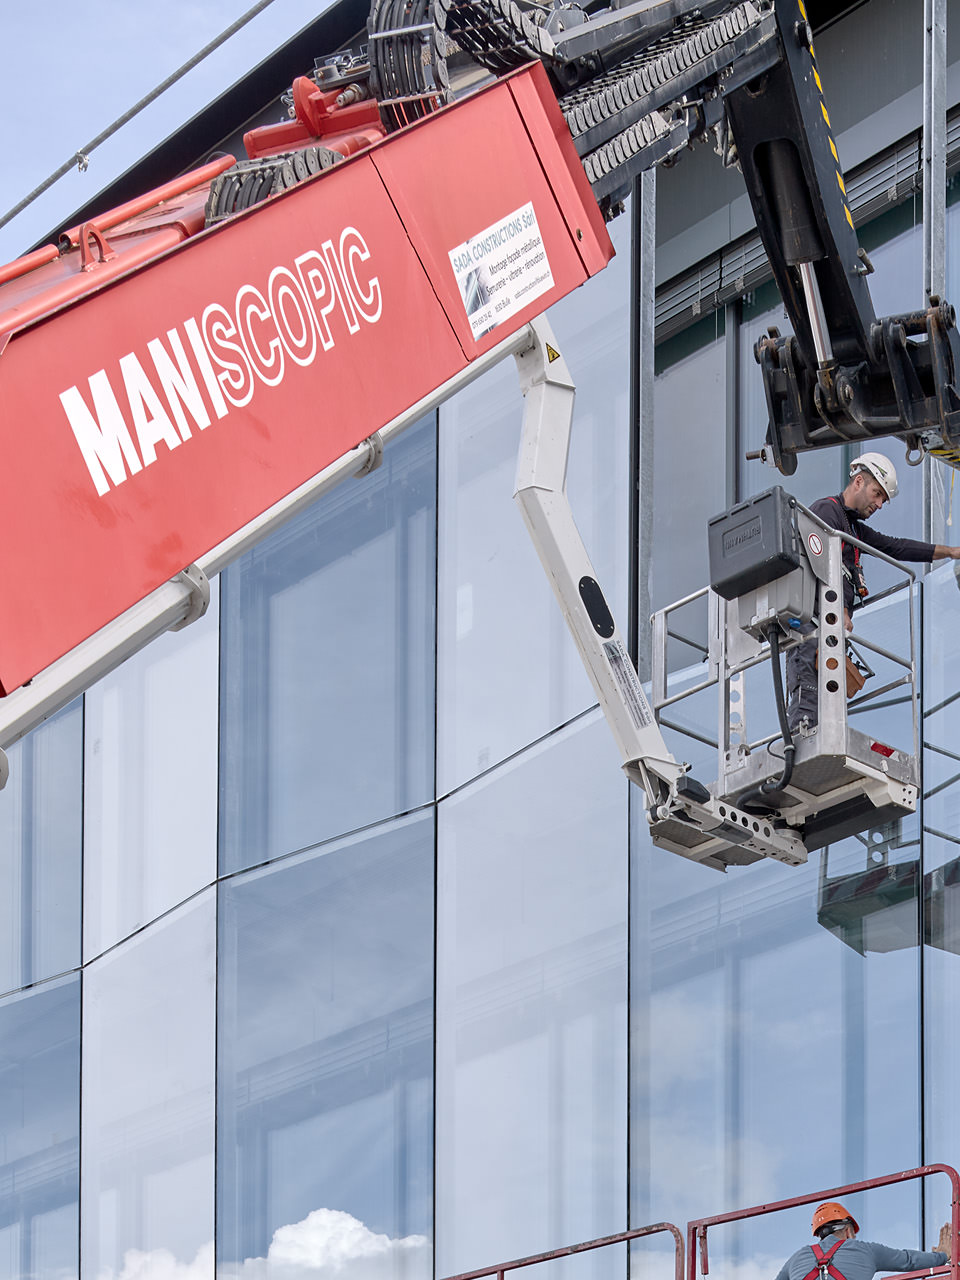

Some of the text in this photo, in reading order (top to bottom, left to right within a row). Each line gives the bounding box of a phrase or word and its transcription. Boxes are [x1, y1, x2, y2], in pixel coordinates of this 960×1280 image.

[453, 249, 474, 274] SADA
[472, 217, 523, 261] CONSTRUCTIONS
[488, 257, 508, 276] Montage
[59, 226, 383, 497] MANISCOPIC
